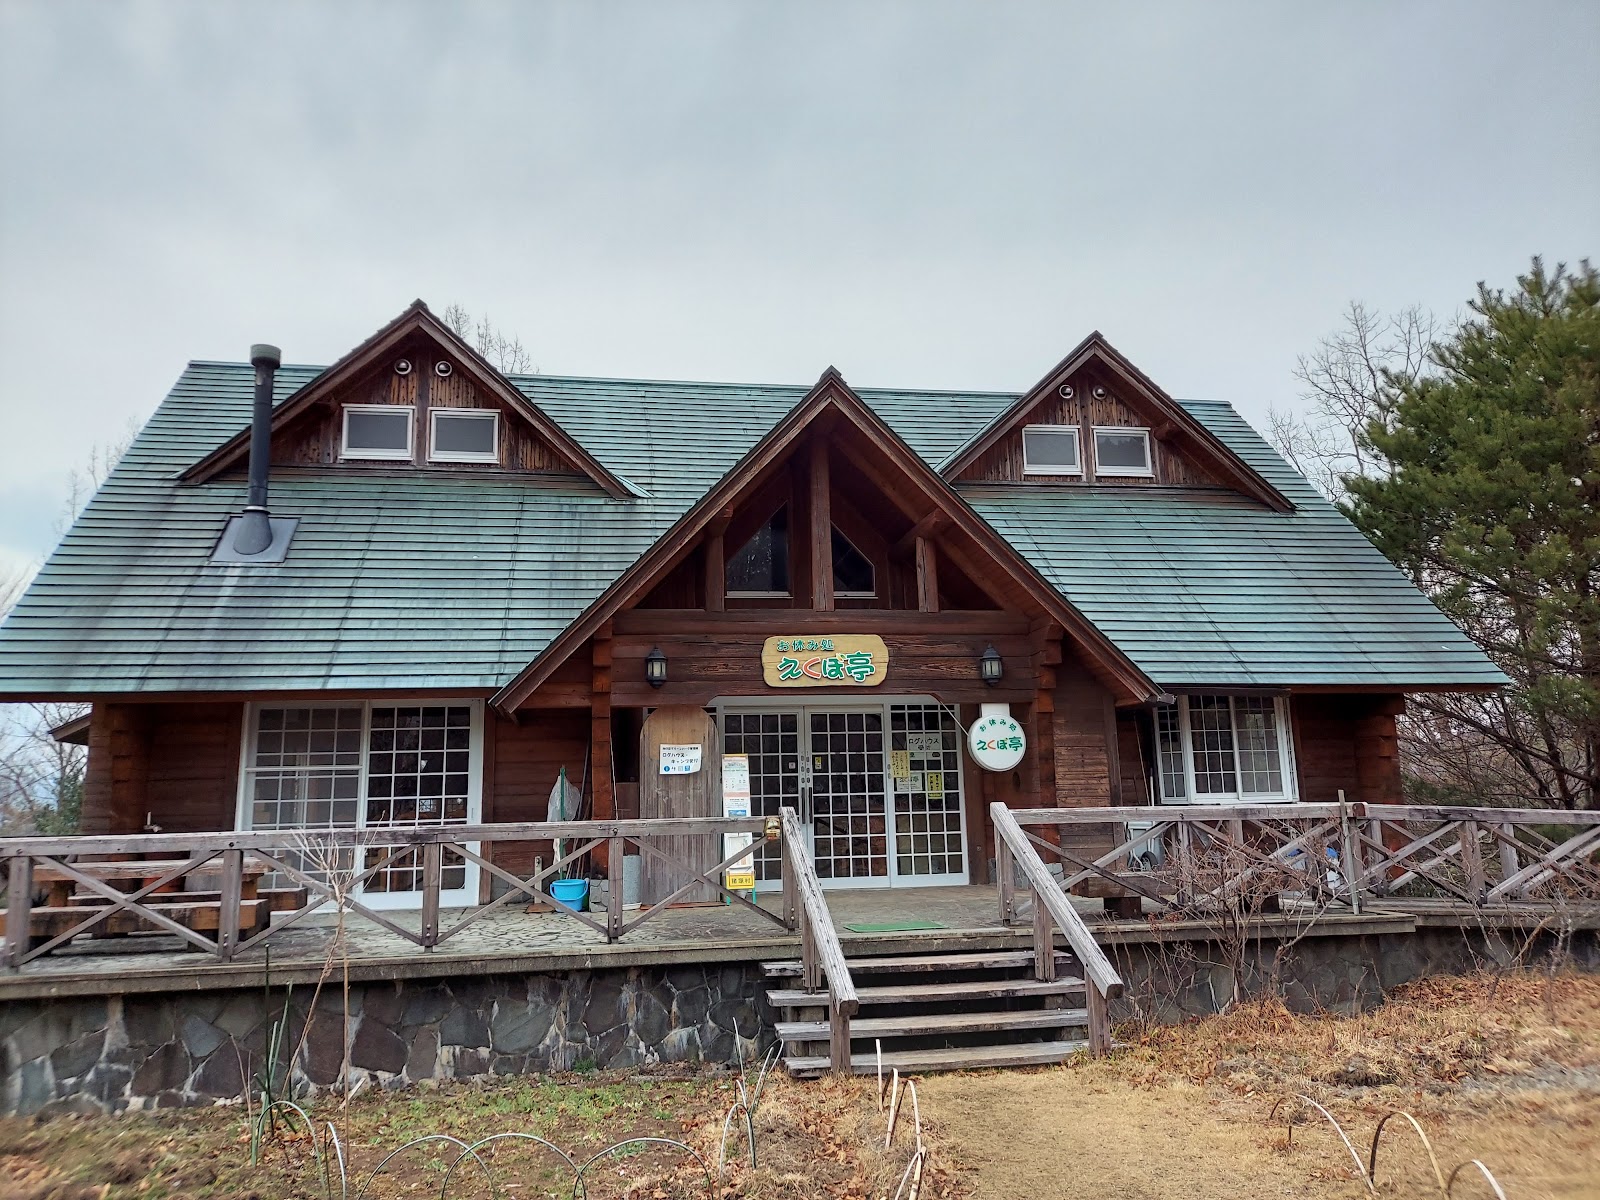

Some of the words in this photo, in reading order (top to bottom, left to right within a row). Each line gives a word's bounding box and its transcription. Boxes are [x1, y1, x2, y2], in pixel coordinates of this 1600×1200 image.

[777, 639, 834, 652] お休み処
[777, 651, 875, 682] えくぼ亭
[979, 719, 1017, 732] お休み処
[976, 736, 1022, 751] えくぼ亭
